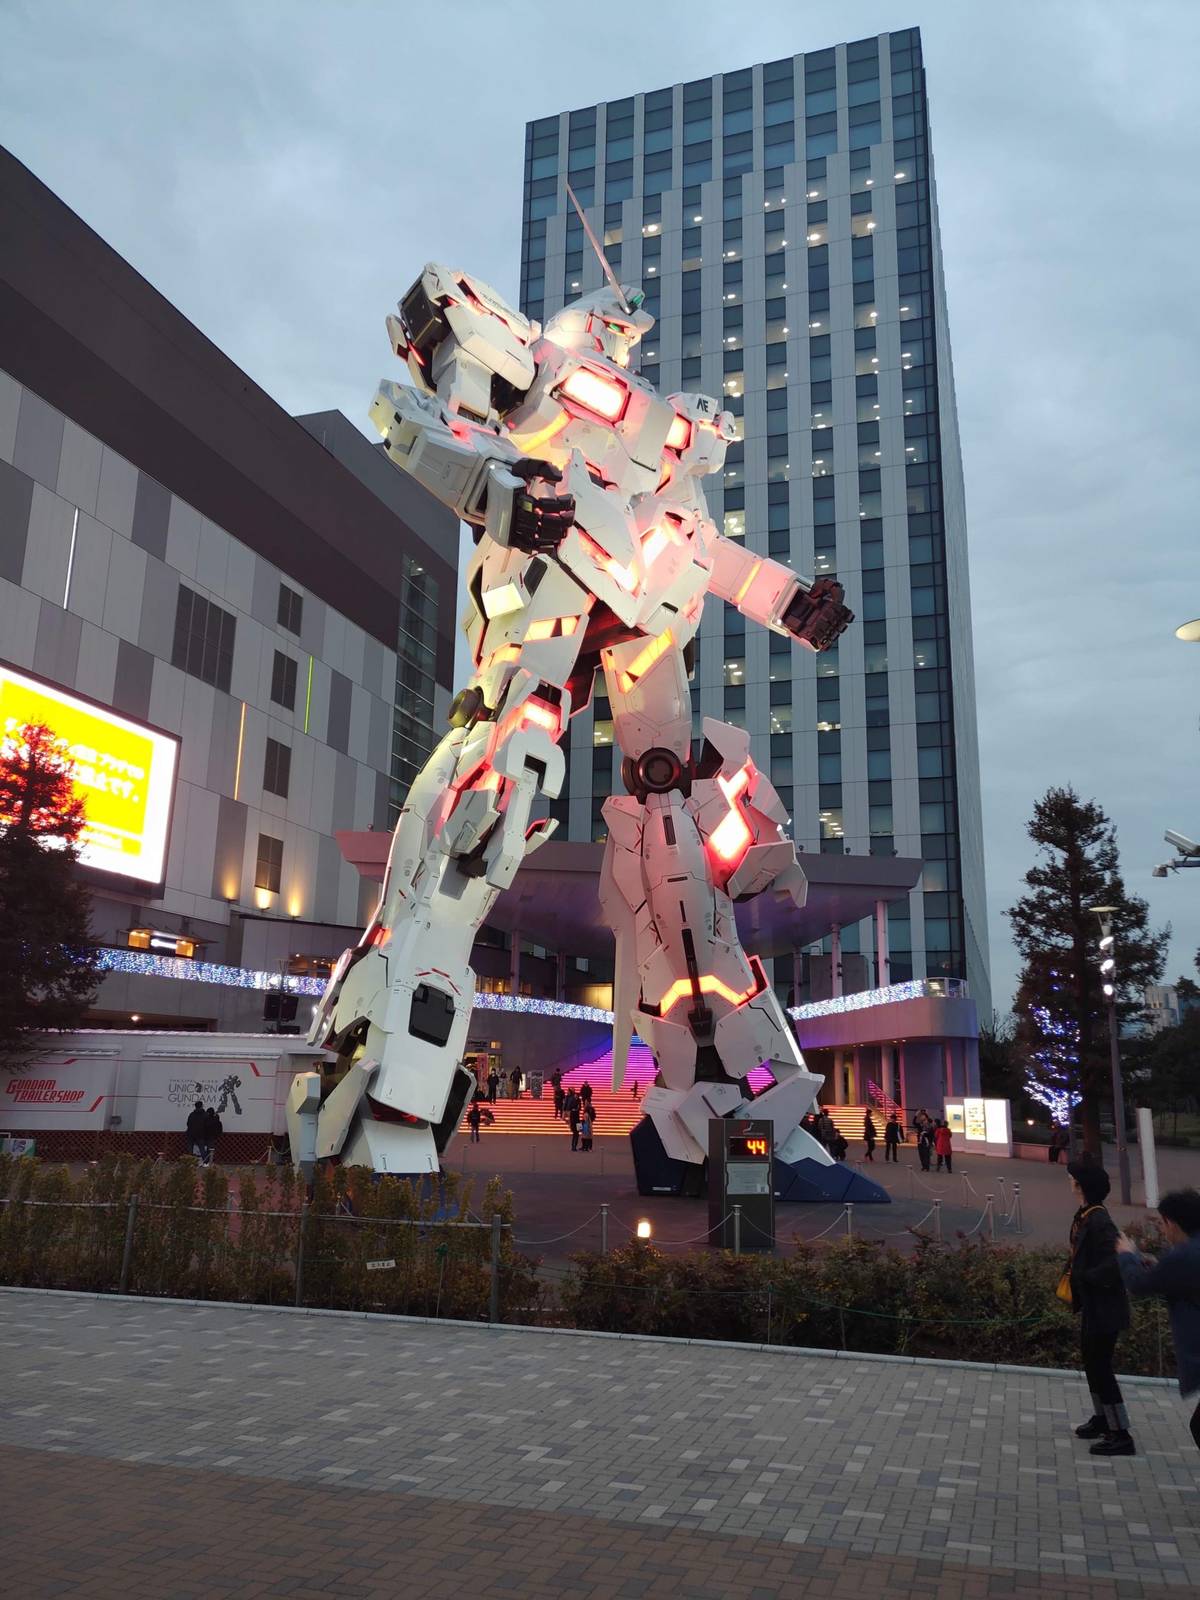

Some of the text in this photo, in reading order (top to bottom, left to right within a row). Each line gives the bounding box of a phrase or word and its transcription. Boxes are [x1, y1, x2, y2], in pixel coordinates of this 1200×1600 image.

[7, 1079, 57, 1094] GUNDAM
[167, 1093, 217, 1103] GUNDAM
[747, 1140, 766, 1155] 44
